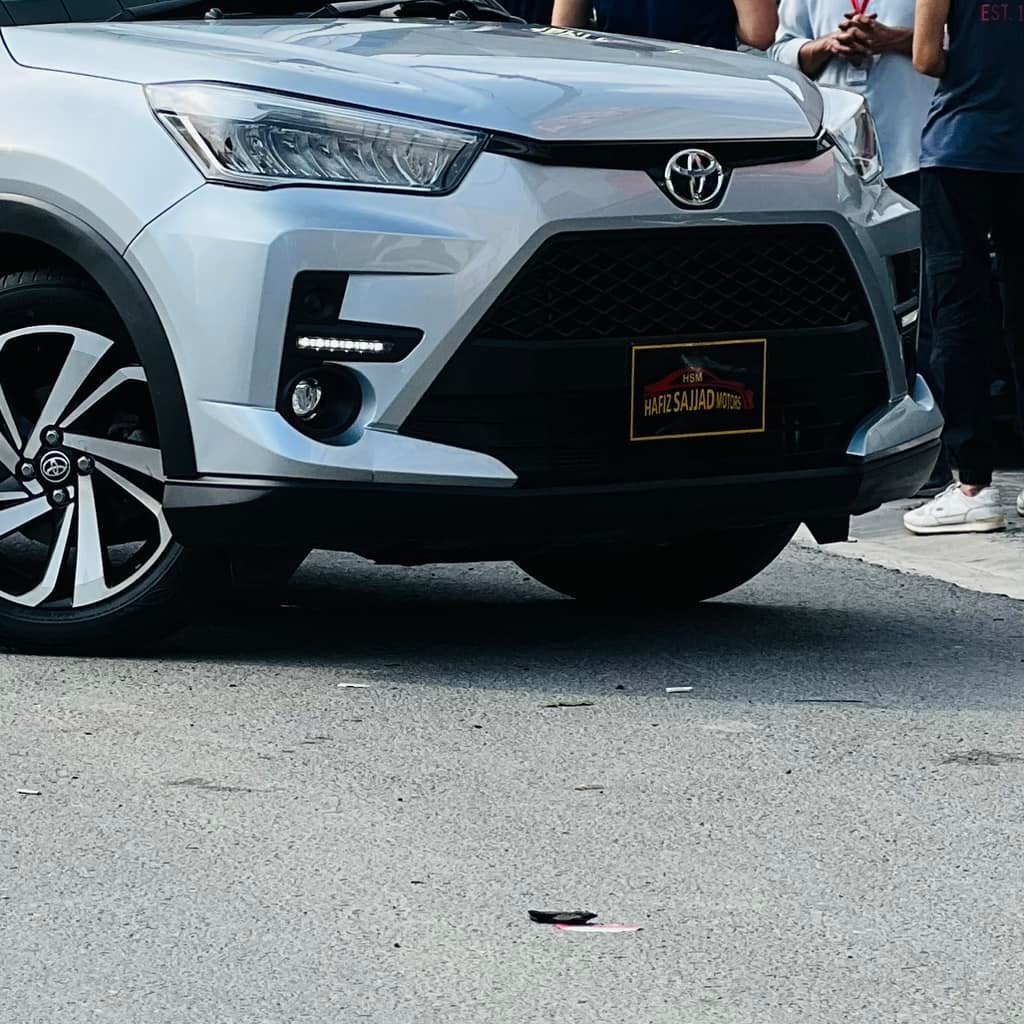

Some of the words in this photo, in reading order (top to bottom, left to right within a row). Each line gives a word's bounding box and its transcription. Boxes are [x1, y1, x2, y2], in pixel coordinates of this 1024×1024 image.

[682, 371, 703, 383] HSM
[644, 394, 672, 416] HAFIZ
[673, 388, 715, 412] SAJJAD
[716, 393, 742, 410] MOTORS
